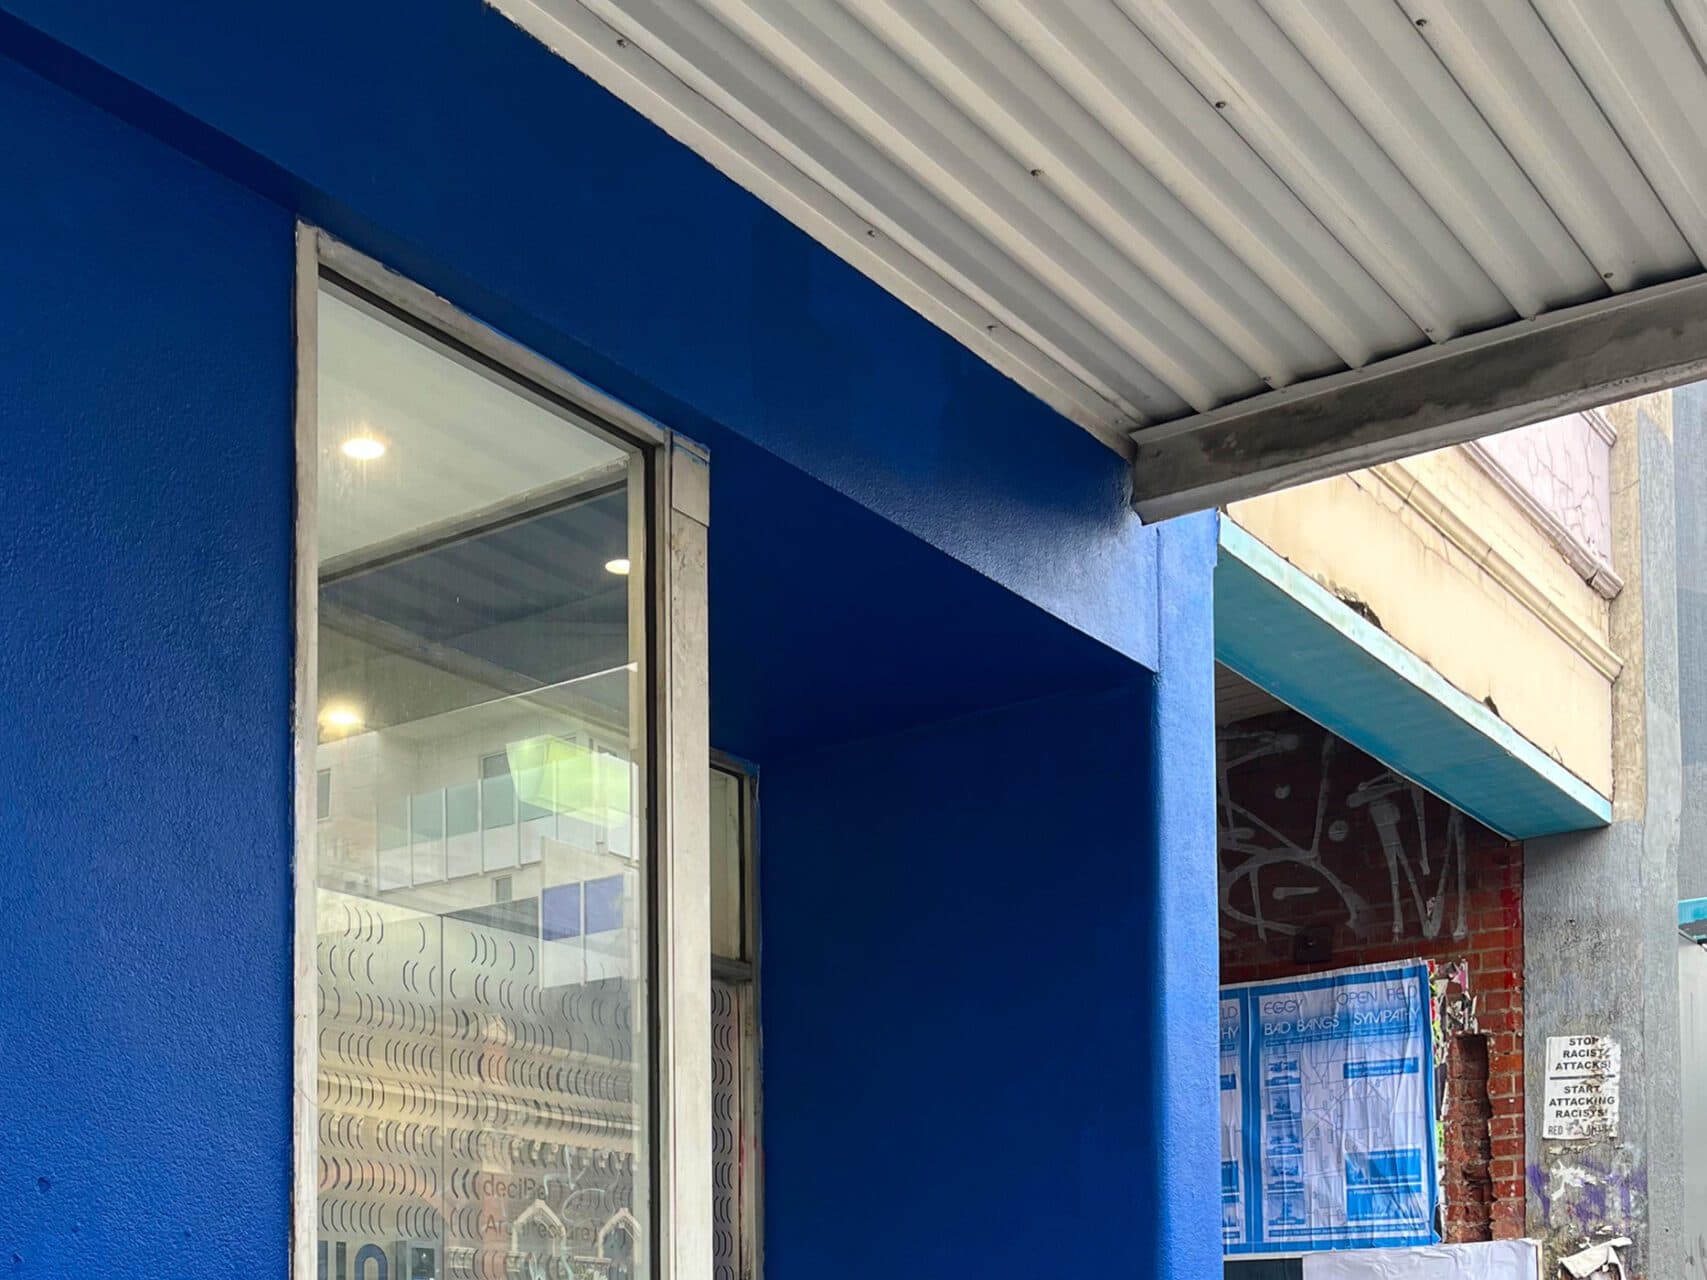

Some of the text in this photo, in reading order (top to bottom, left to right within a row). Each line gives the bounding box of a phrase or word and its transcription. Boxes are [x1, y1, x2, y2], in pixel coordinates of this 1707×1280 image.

[1264, 999, 1304, 1015] EGGY
[1337, 990, 1378, 1007] OPEN
[1264, 1021, 1291, 1036] BAD
[1296, 1014, 1340, 1033] BANGS
[1569, 1037, 1599, 1046] STOP
[1563, 1085, 1601, 1094] START
[1549, 1096, 1615, 1106] ATTACKING
